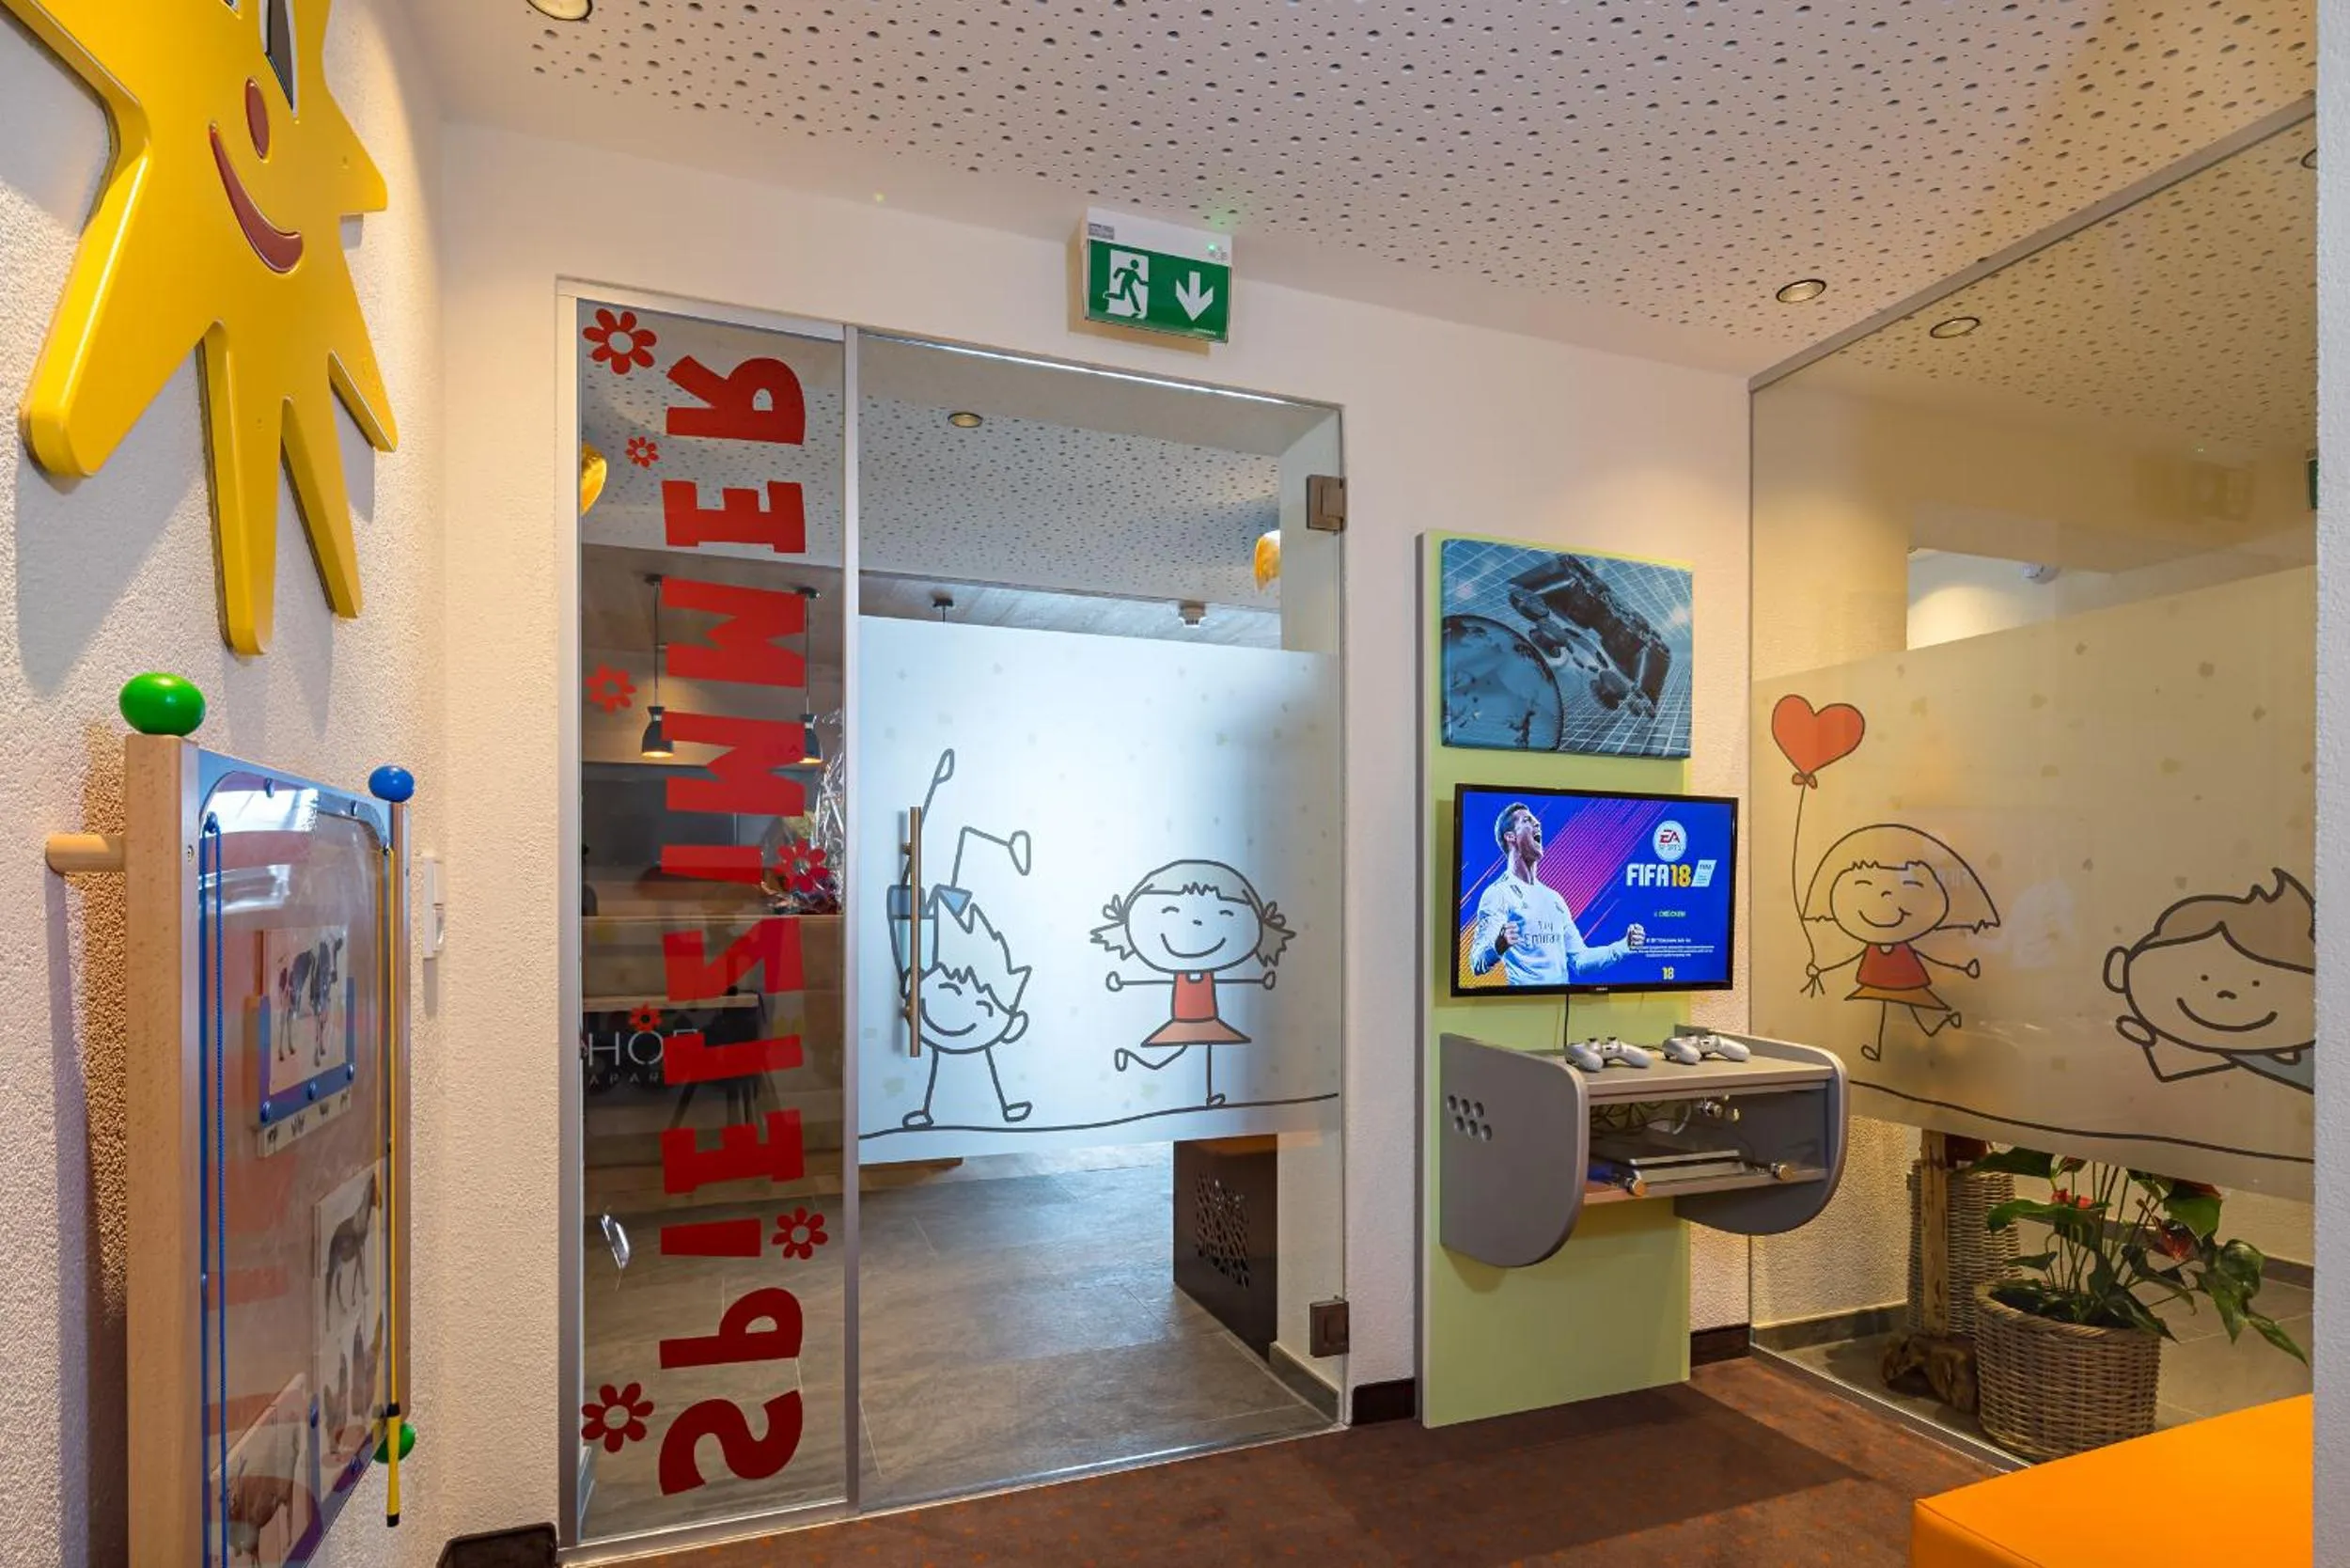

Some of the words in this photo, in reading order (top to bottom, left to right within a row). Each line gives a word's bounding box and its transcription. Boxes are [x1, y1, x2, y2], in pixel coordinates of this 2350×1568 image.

[1659, 829, 1681, 843] EA
[1662, 966, 1674, 980] 18
[588, 1028, 698, 1066] HO
